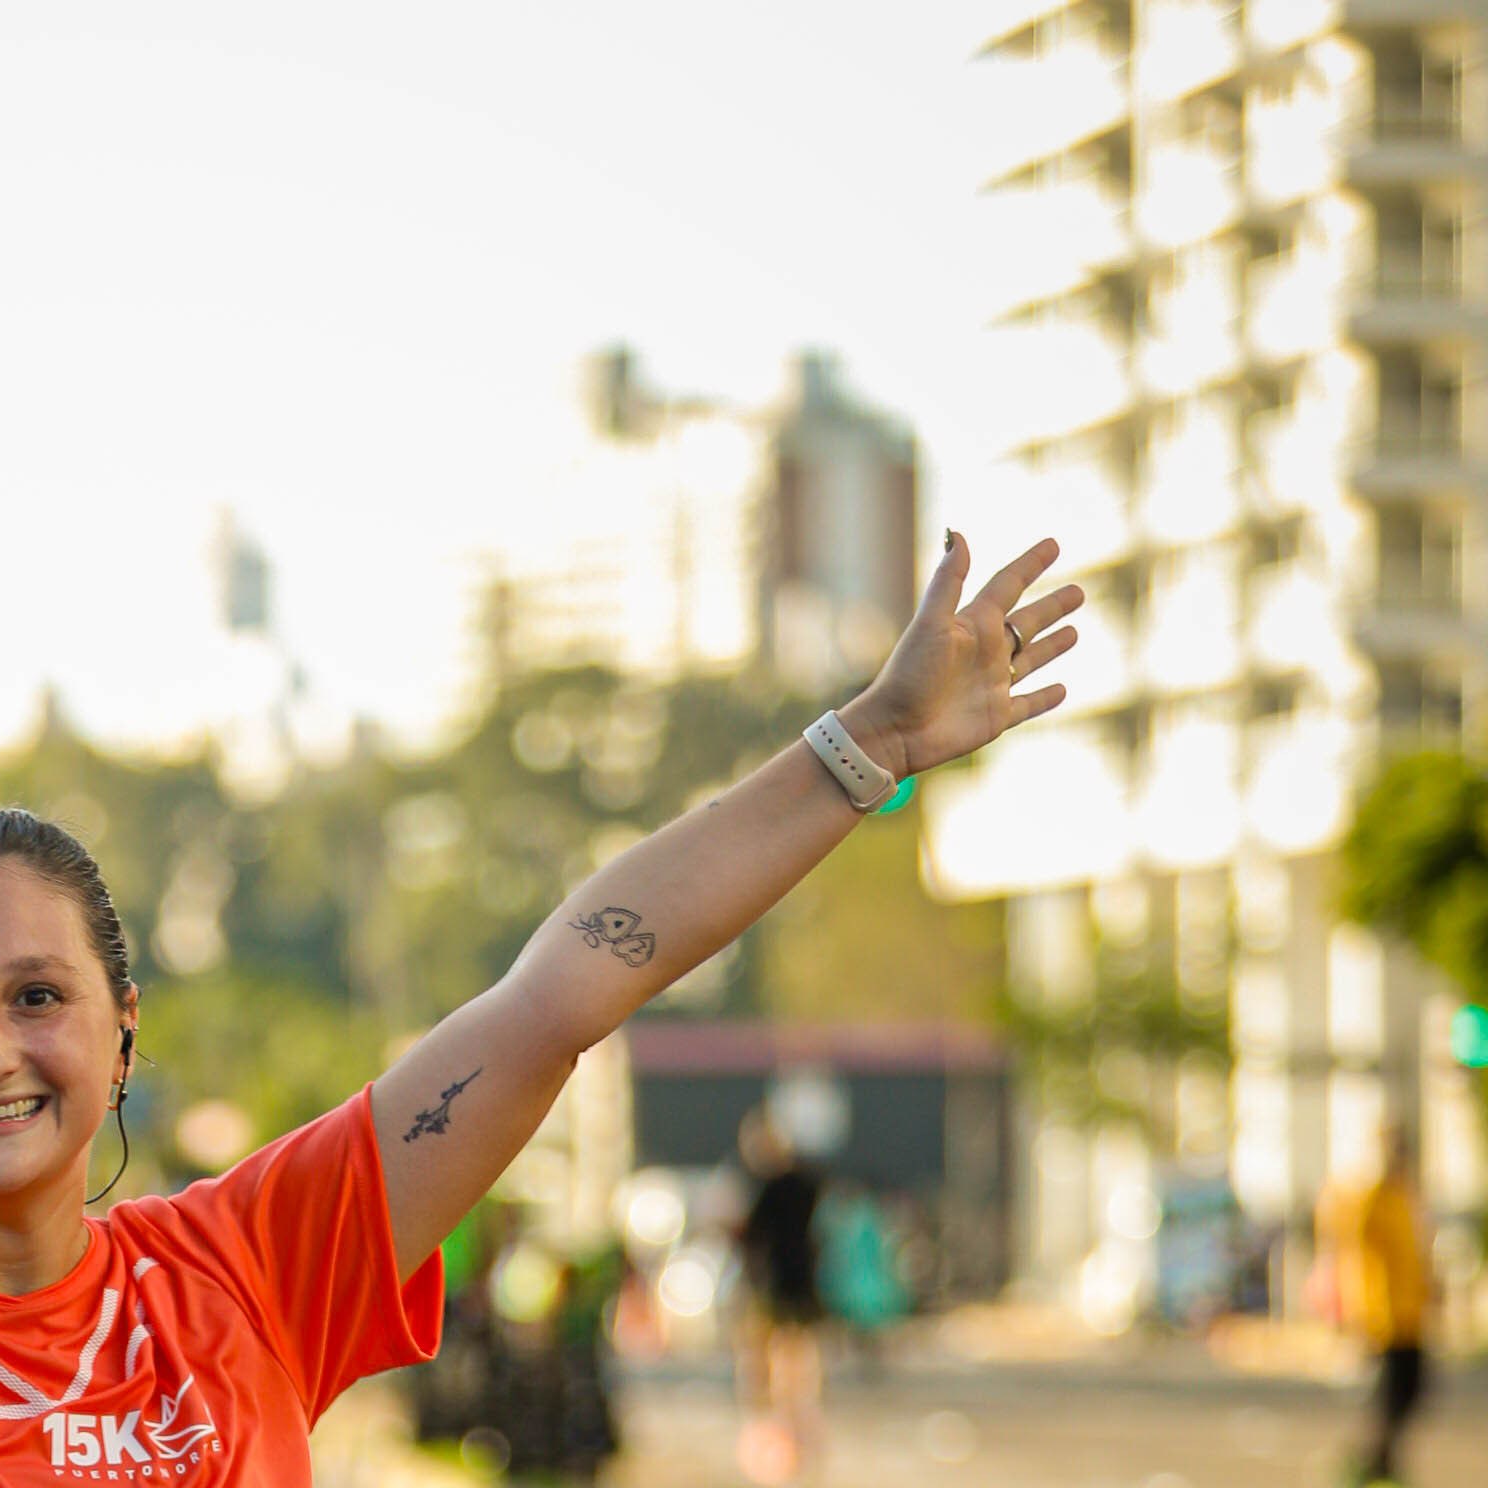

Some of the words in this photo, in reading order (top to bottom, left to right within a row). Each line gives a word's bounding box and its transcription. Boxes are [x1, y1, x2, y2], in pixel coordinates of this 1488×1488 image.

[43, 1410, 152, 1466] 15K
[54, 1464, 153, 1480] PUERTO
[159, 1440, 221, 1479] NORE
